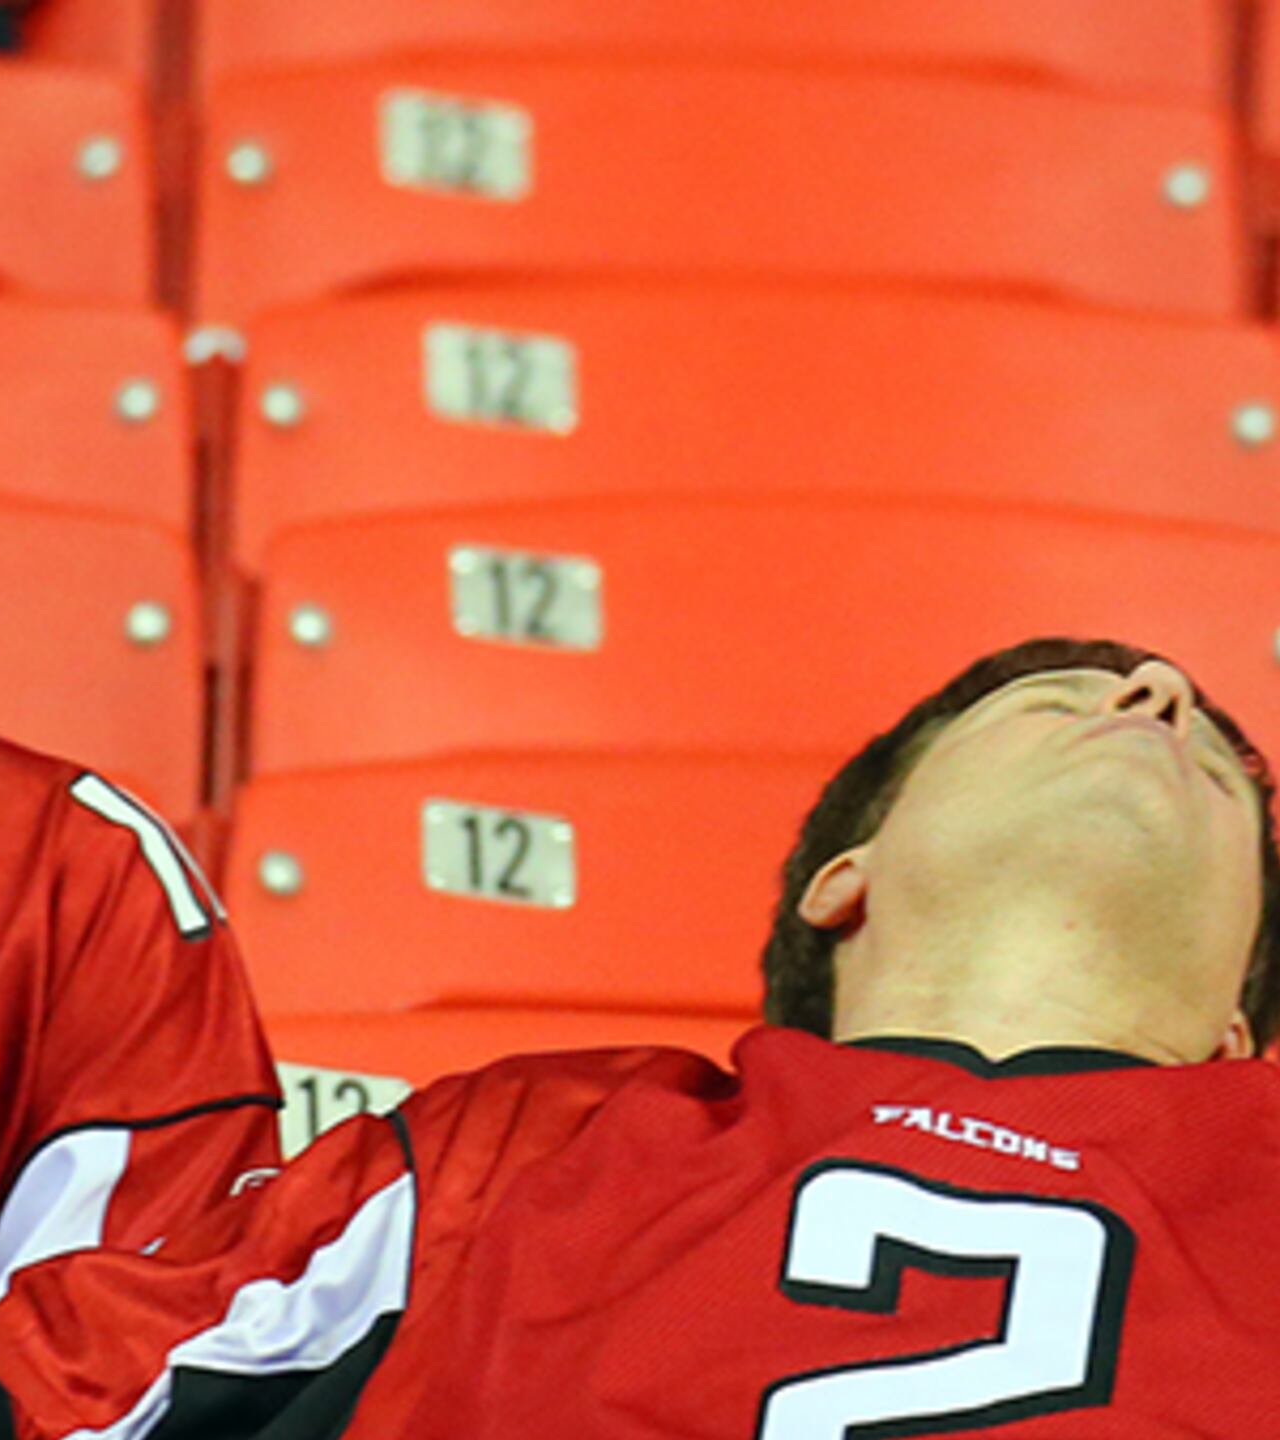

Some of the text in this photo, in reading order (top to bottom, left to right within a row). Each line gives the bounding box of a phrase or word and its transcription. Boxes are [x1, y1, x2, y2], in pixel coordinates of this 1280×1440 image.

[492, 559, 559, 641] 12
[68, 770, 228, 942] 1
[461, 814, 531, 901] 12
[872, 1106, 1080, 1171] FALCONS
